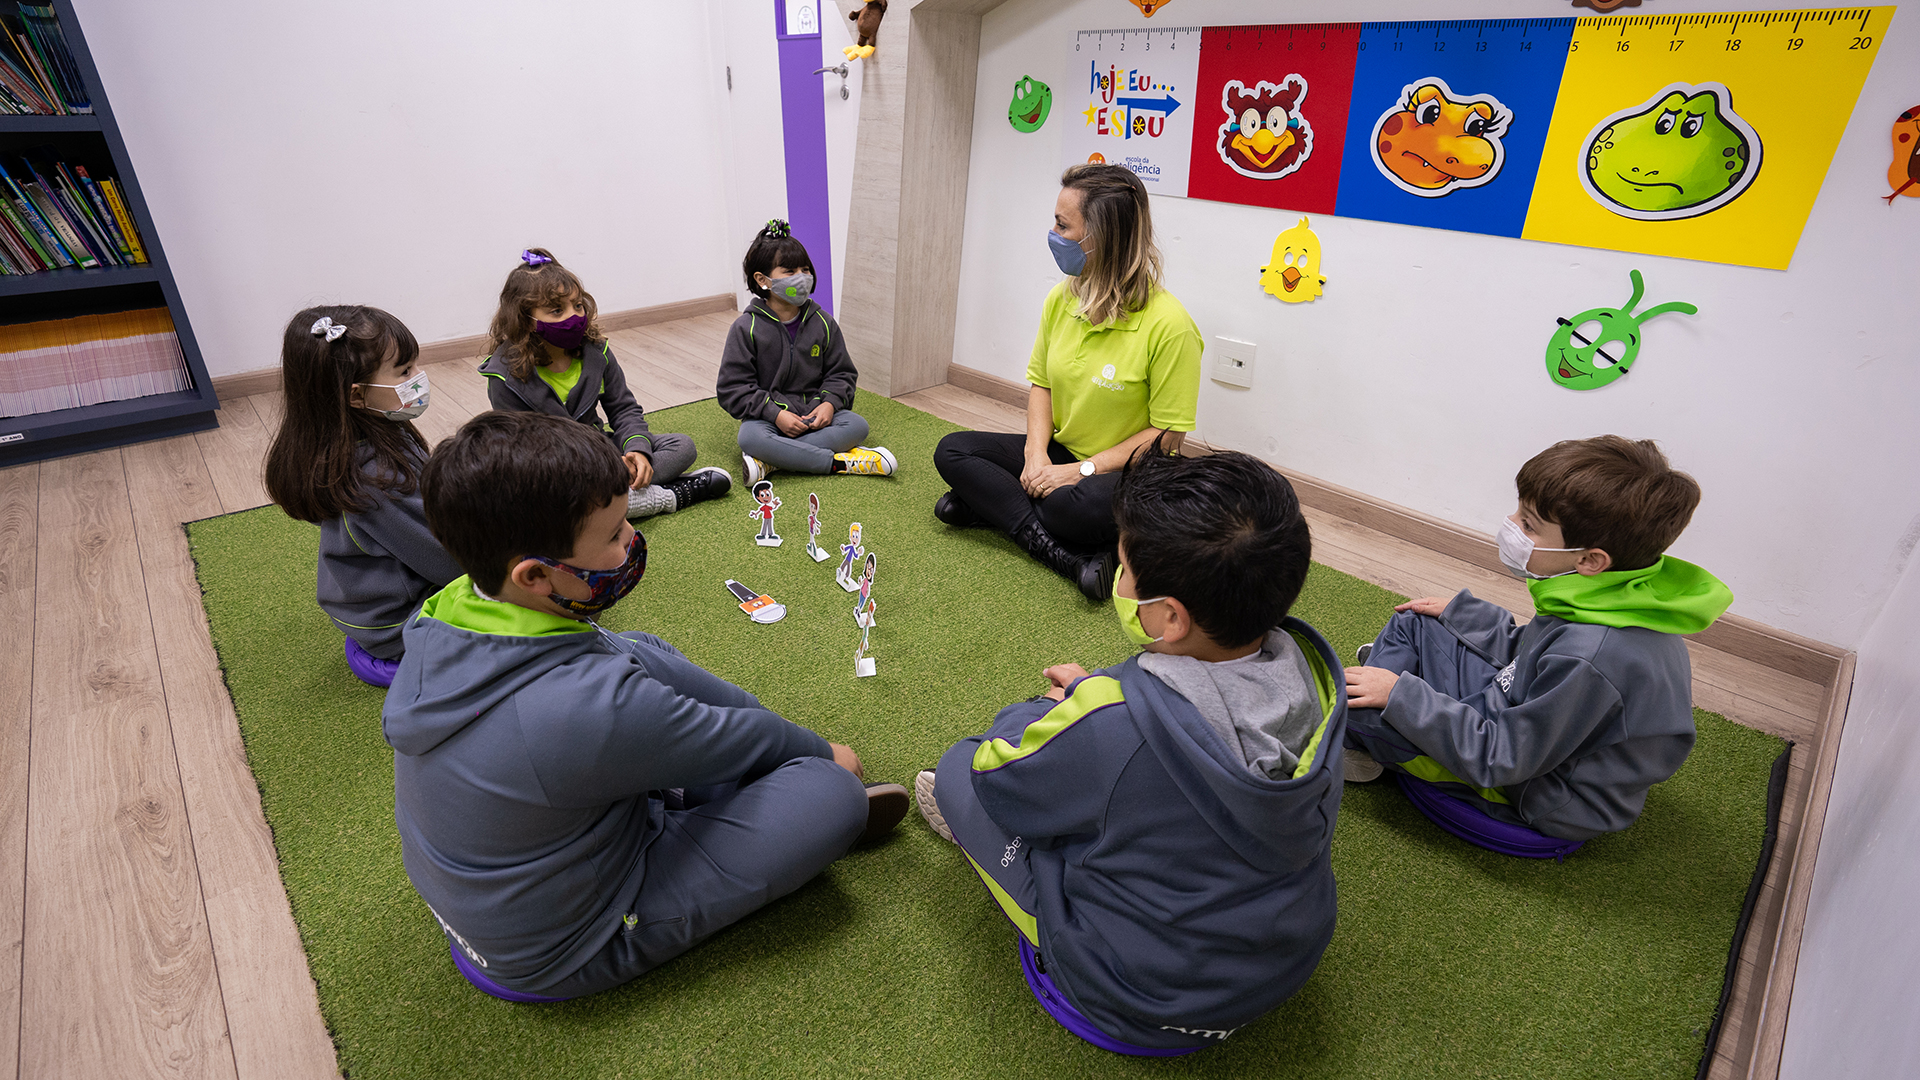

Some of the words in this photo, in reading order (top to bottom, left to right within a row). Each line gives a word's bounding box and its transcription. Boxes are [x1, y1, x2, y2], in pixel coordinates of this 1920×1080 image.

[1076, 43, 1080, 51] 0
[1120, 43, 1125, 51] 2
[1146, 43, 1150, 51] 3
[1170, 43, 1175, 51] 4
[1199, 42, 1203, 50] 5
[1226, 42, 1232, 50] 6
[1258, 42, 1262, 50] 7
[1288, 42, 1293, 51] 8
[1320, 42, 1326, 51] 9
[1356, 42, 1367, 51] 10
[1393, 42, 1403, 51] 11
[1434, 42, 1445, 52] 12
[1475, 42, 1488, 52] 13
[1519, 41, 1532, 52] 14
[1566, 41, 1579, 52] 15
[1616, 40, 1630, 52] 16
[1669, 40, 1684, 52] 17
[1725, 39, 1742, 52] 18
[1787, 38, 1804, 51] 19
[1849, 36, 1872, 50] 20
